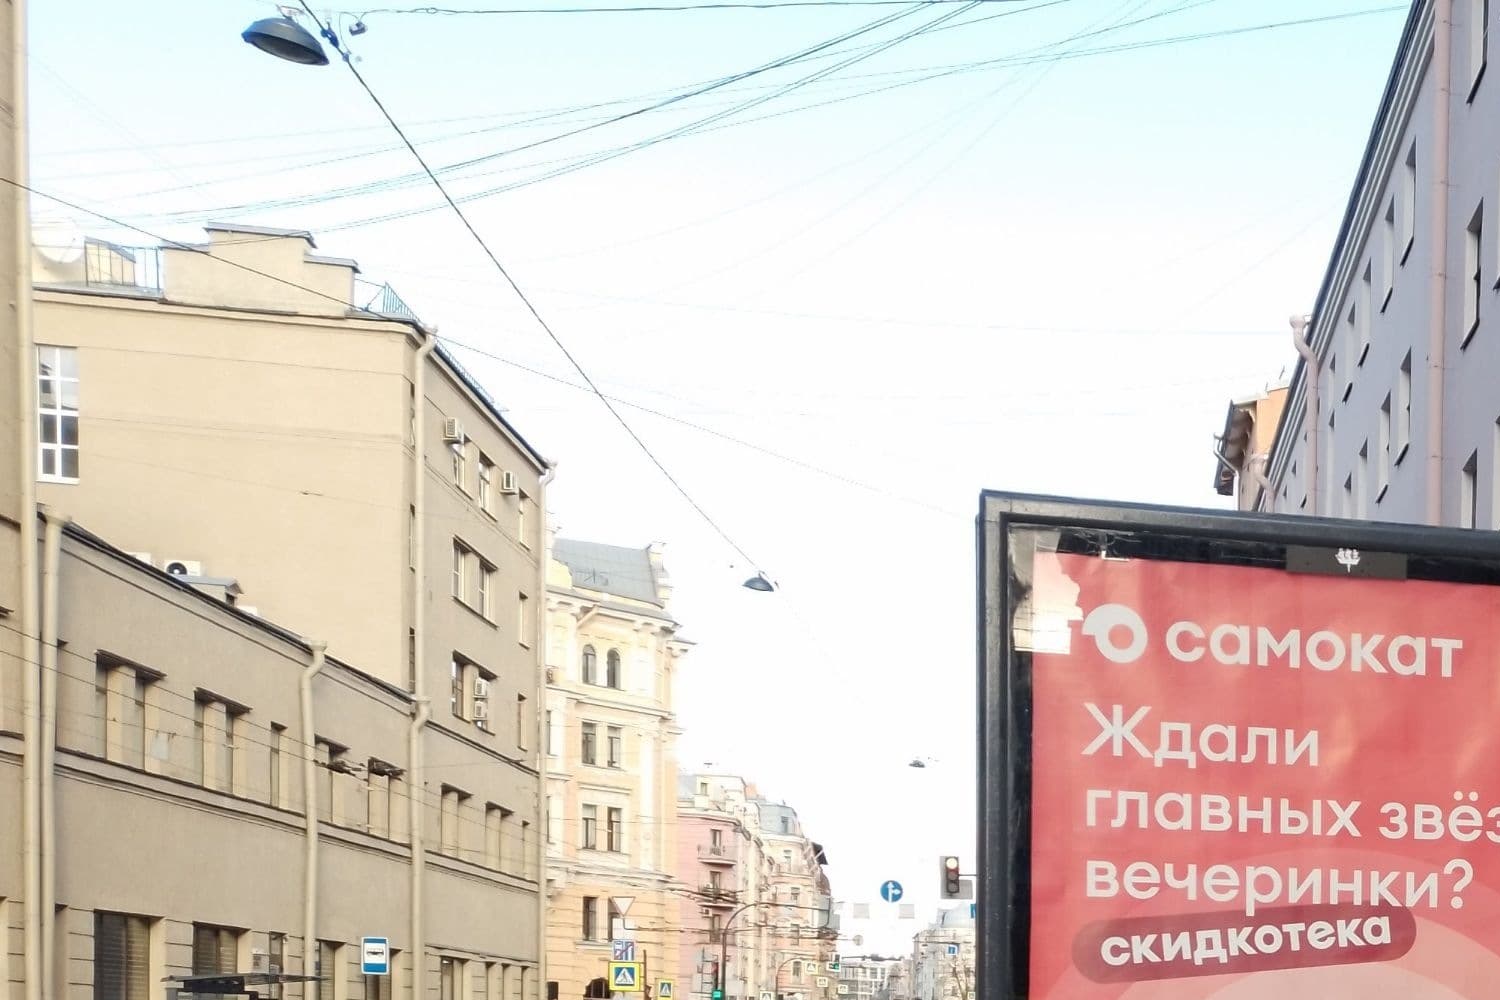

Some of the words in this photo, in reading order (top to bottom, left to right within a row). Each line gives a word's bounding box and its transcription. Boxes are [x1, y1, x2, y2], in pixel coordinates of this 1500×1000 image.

[1165, 618, 1464, 679] самокат
[1081, 702, 1319, 768] Ждали
[1085, 788, 1362, 837] главных
[1085, 858, 1474, 916] вечеринки?
[1100, 915, 1392, 967] скидкотека
